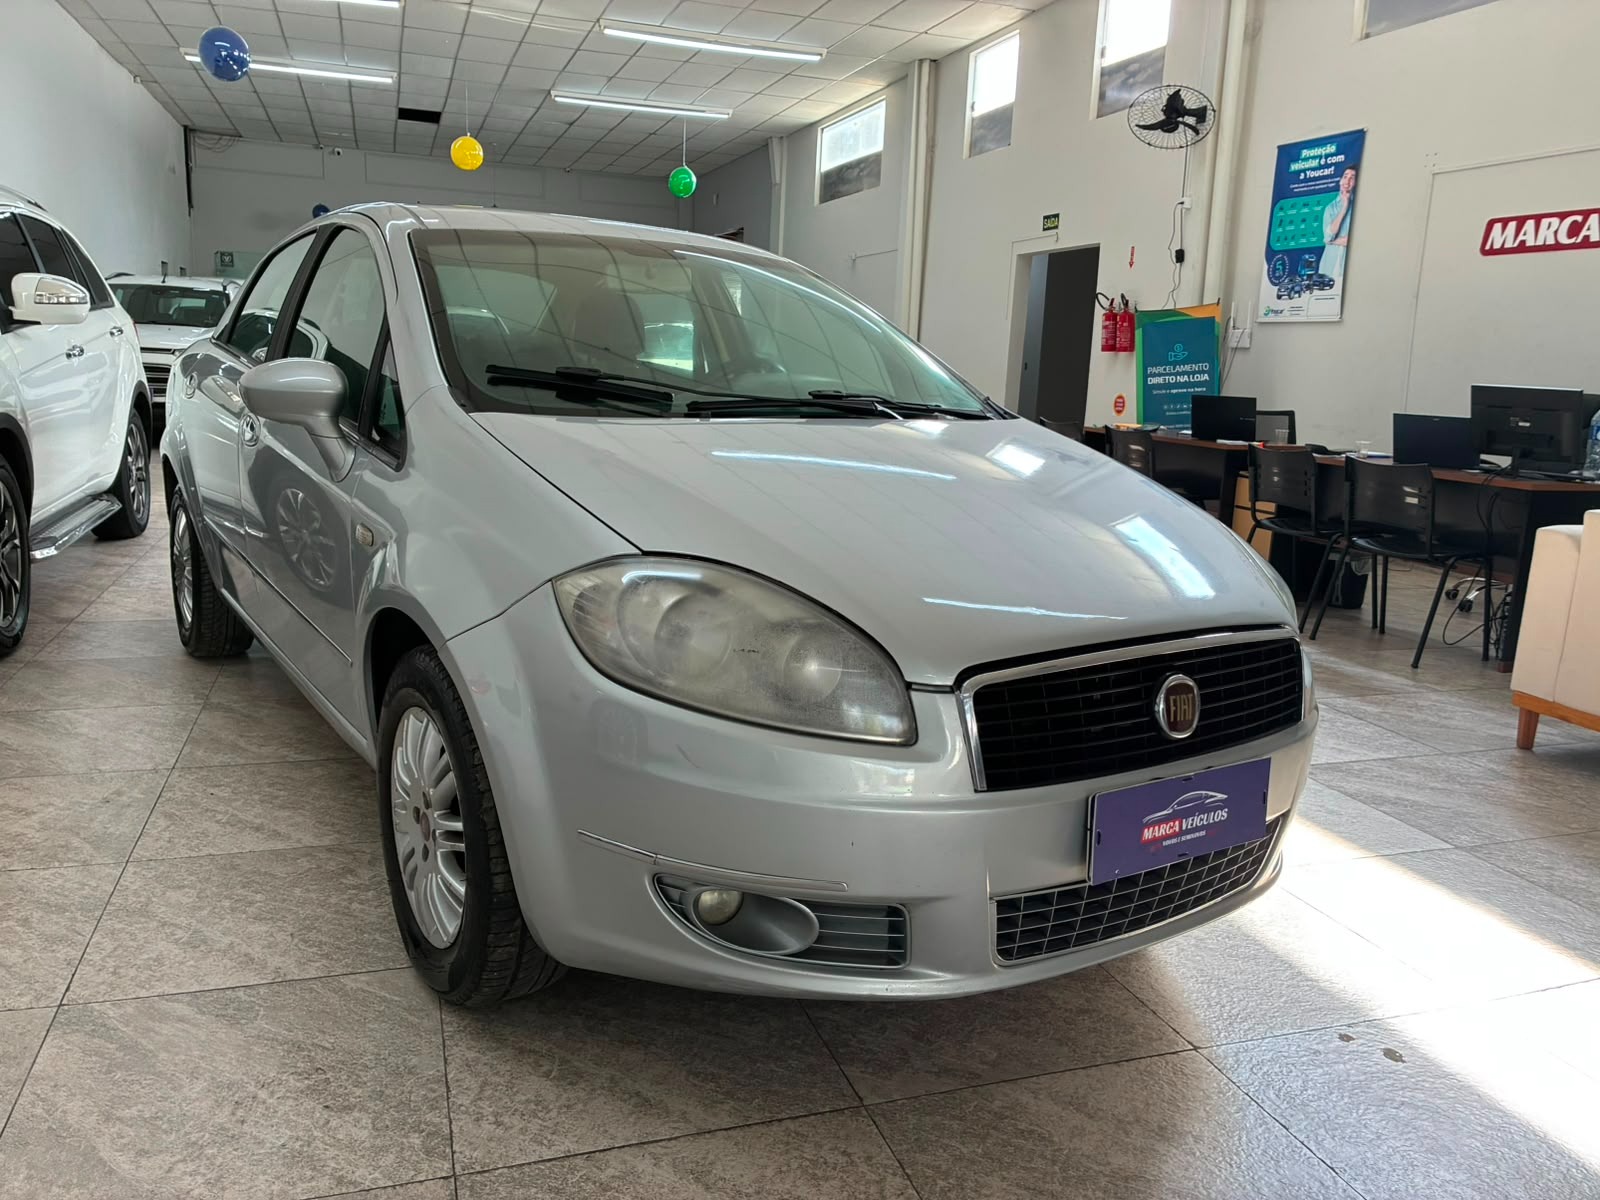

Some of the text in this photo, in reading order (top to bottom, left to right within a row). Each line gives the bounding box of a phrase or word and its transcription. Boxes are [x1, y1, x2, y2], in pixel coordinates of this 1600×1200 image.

[1290, 158, 1319, 171] veicular
[1327, 154, 1345, 164] com
[1484, 213, 1600, 250] MARCA
[1147, 362, 1209, 374] PARCELAMENTO
[1147, 373, 1210, 385] DIRETO NA LOJA
[1170, 694, 1193, 722] FIAT
[1142, 808, 1229, 840] MARCA VEÍCULOS
